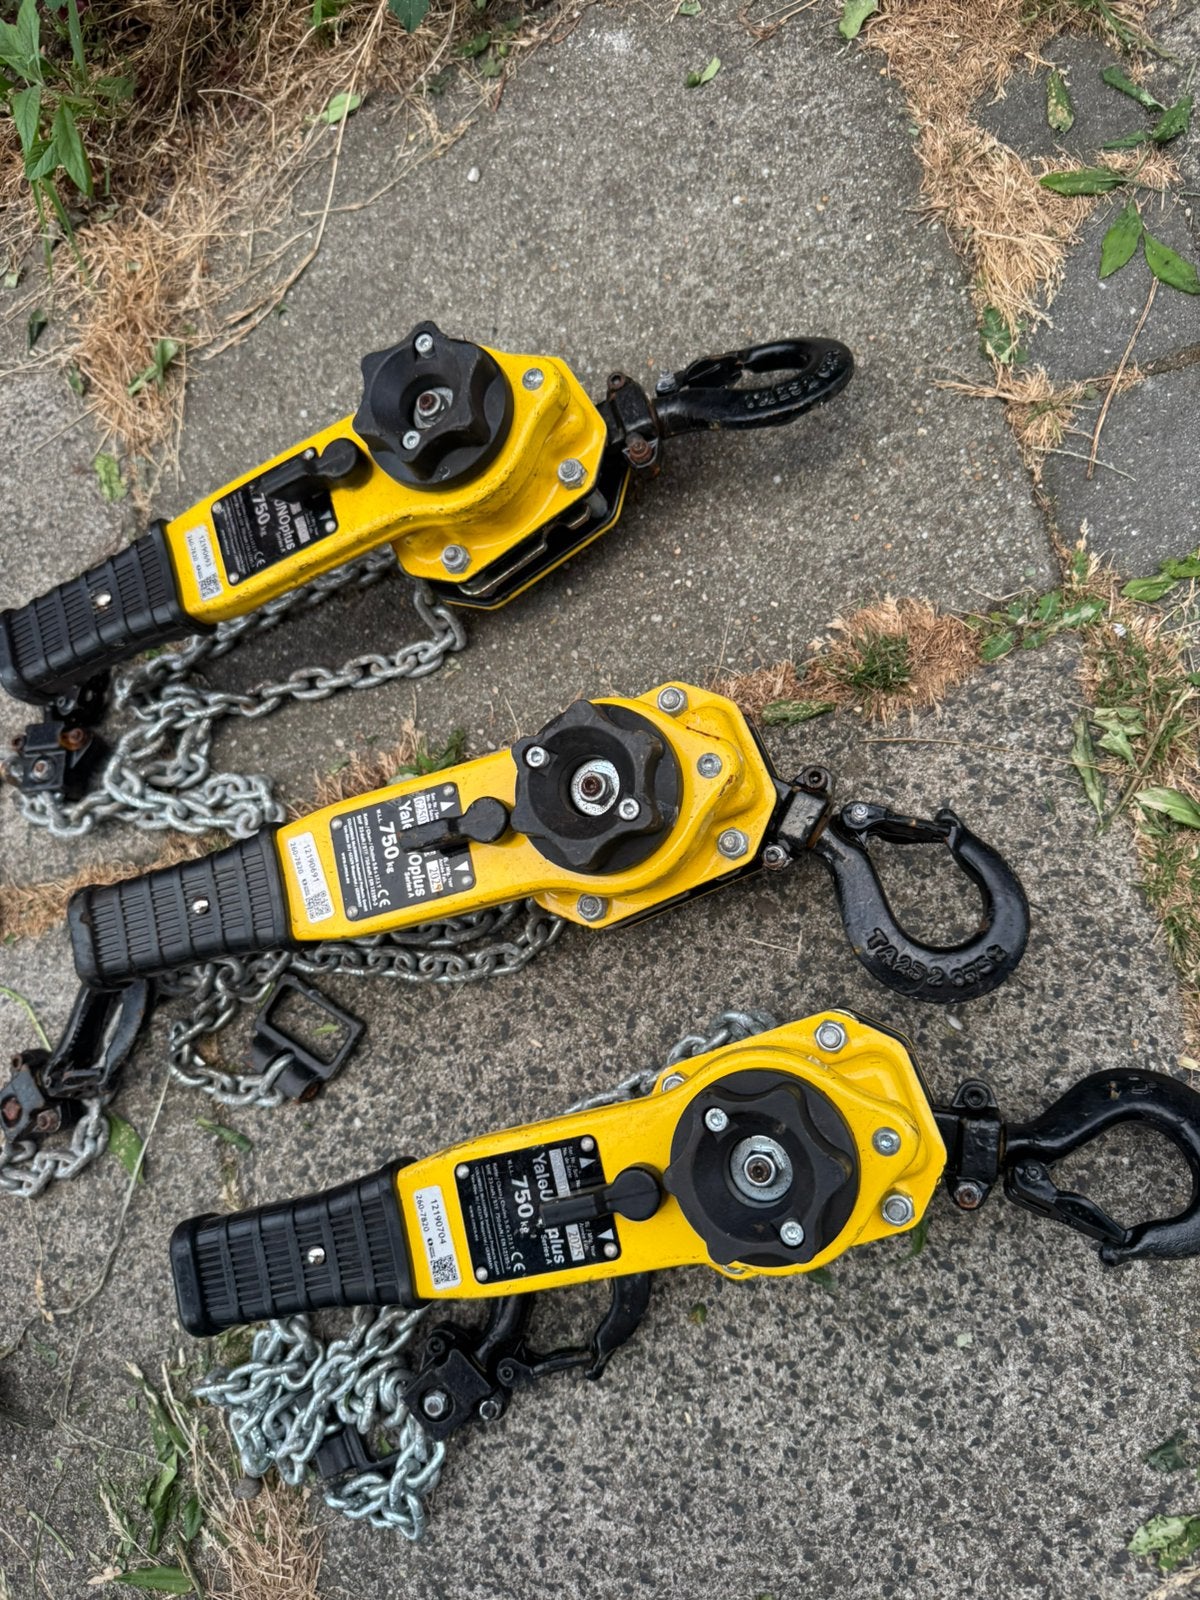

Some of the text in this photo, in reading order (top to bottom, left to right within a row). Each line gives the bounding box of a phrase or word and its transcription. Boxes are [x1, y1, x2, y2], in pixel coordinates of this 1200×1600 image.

[251, 492, 271, 526] 750
[378, 820, 400, 861] 750
[289, 841, 304, 875] 260-7820
[302, 844, 319, 883] 12190691
[384, 860, 396, 874] kg
[403, 870, 413, 892] Series
[415, 1194, 430, 1233] 260-7820
[509, 1174, 535, 1219] 750
[429, 1198, 447, 1245] 12190704
[517, 1219, 531, 1235] kg
[539, 1233, 553, 1265] Series A
[567, 1229, 583, 1258] 2025
